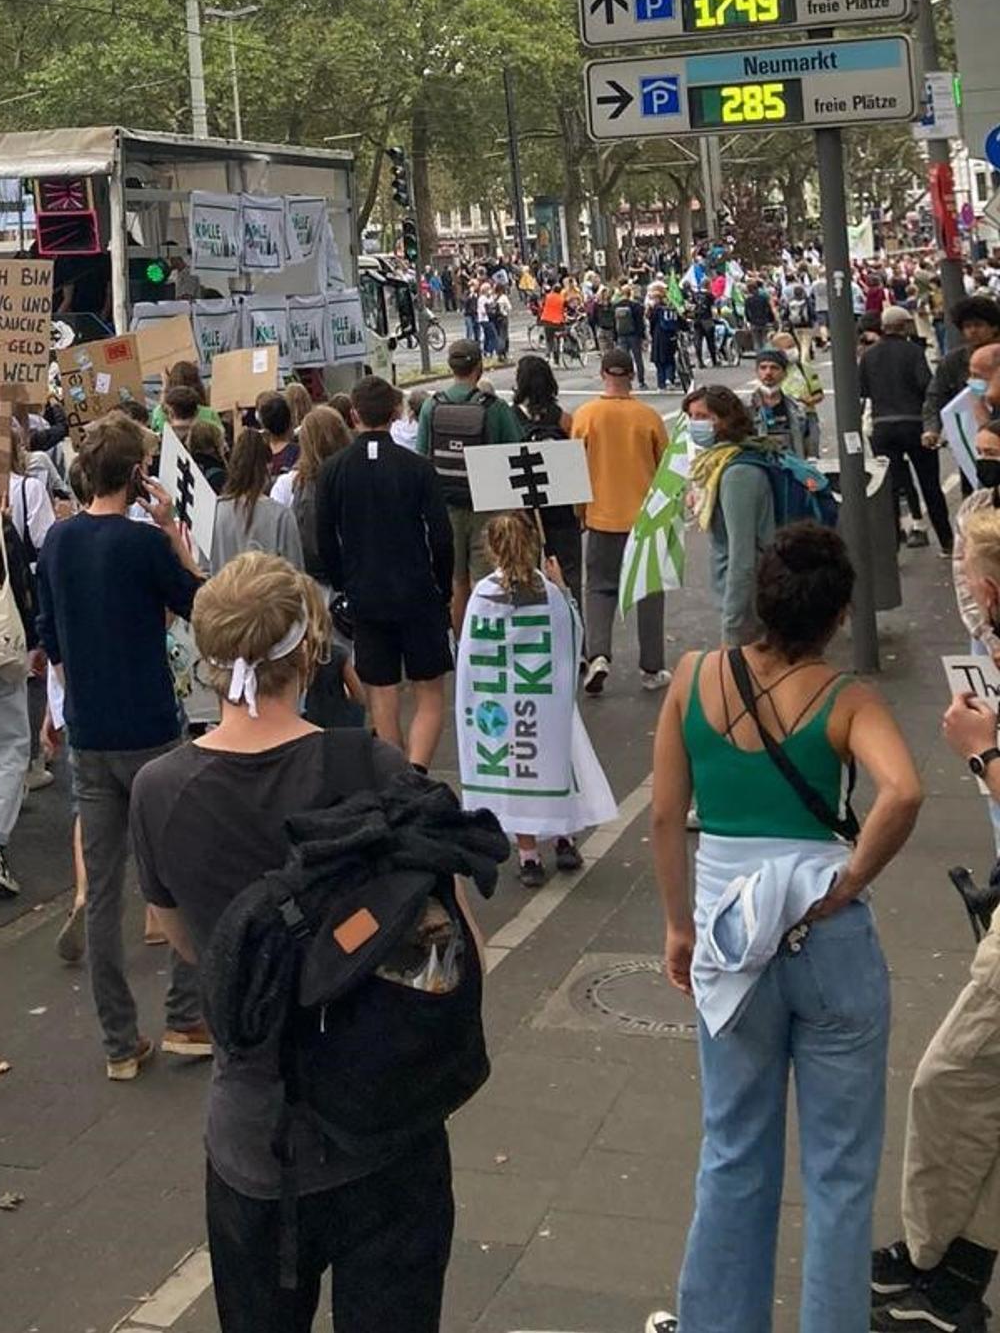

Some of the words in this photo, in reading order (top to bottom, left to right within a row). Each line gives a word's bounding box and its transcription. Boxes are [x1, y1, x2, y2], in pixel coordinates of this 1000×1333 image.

[743, 51, 839, 78] Neumarkt
[721, 83, 786, 123] 285
[813, 96, 848, 114] freie
[852, 92, 898, 111] Plätze
[20, 267, 51, 286] BIN
[21, 295, 51, 313] UND
[8, 338, 45, 355] GELD
[2, 361, 48, 383] WELT
[465, 614, 510, 778] KÖLLE
[510, 699, 539, 779] FÜRS
